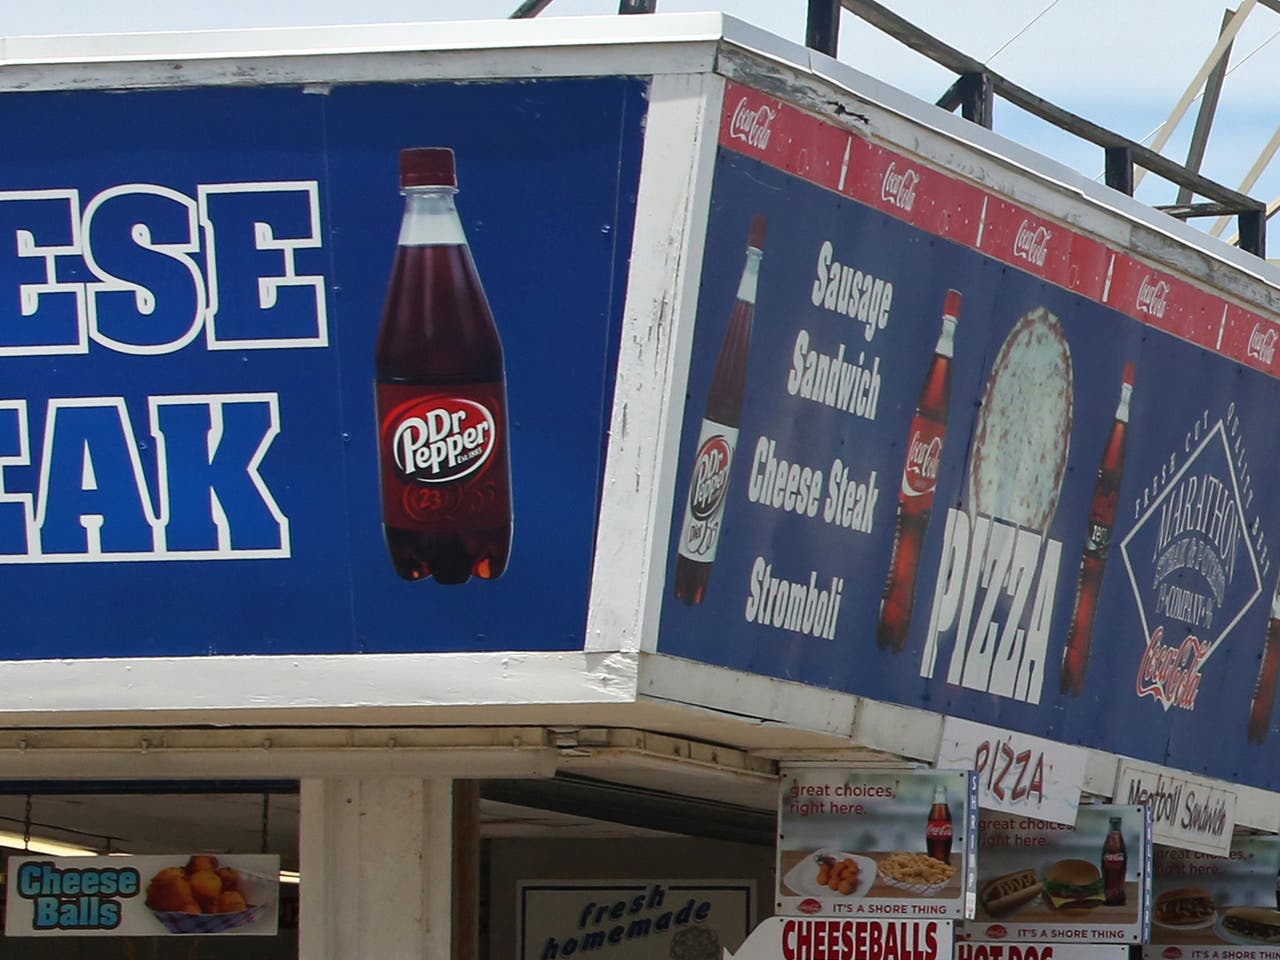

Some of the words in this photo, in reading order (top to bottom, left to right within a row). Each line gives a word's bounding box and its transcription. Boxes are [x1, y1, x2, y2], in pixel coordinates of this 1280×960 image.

[811, 240, 894, 342] Sausage
[787, 330, 883, 420] Sandwich
[394, 417, 489, 474] Pepper
[426, 408, 466, 443] Dr
[748, 436, 824, 517] Cheese
[823, 458, 879, 534] Steak
[745, 556, 845, 640] Stromboli
[919, 507, 1063, 705] PIZZA
[975, 736, 1044, 803] PIZZA
[790, 784, 831, 800] great
[834, 784, 896, 799] choices,
[790, 801, 827, 817] right
[1128, 778, 1183, 828] Meatball
[979, 819, 1015, 831] great
[19, 862, 139, 896] Cheese
[35, 898, 120, 928] Balls
[578, 884, 666, 928] fresh
[833, 904, 856, 915] IT'S
[858, 904, 867, 915] A
[871, 904, 908, 915] SHORE
[910, 904, 948, 915] THING
[541, 899, 712, 960] homemade
[1018, 929, 1038, 938] IT'S
[1051, 930, 1089, 938] SHORE
[1092, 930, 1125, 939] THING
[1192, 951, 1209, 959] IT'S
[1214, 951, 1220, 959] A
[1226, 952, 1256, 960] SHORE
